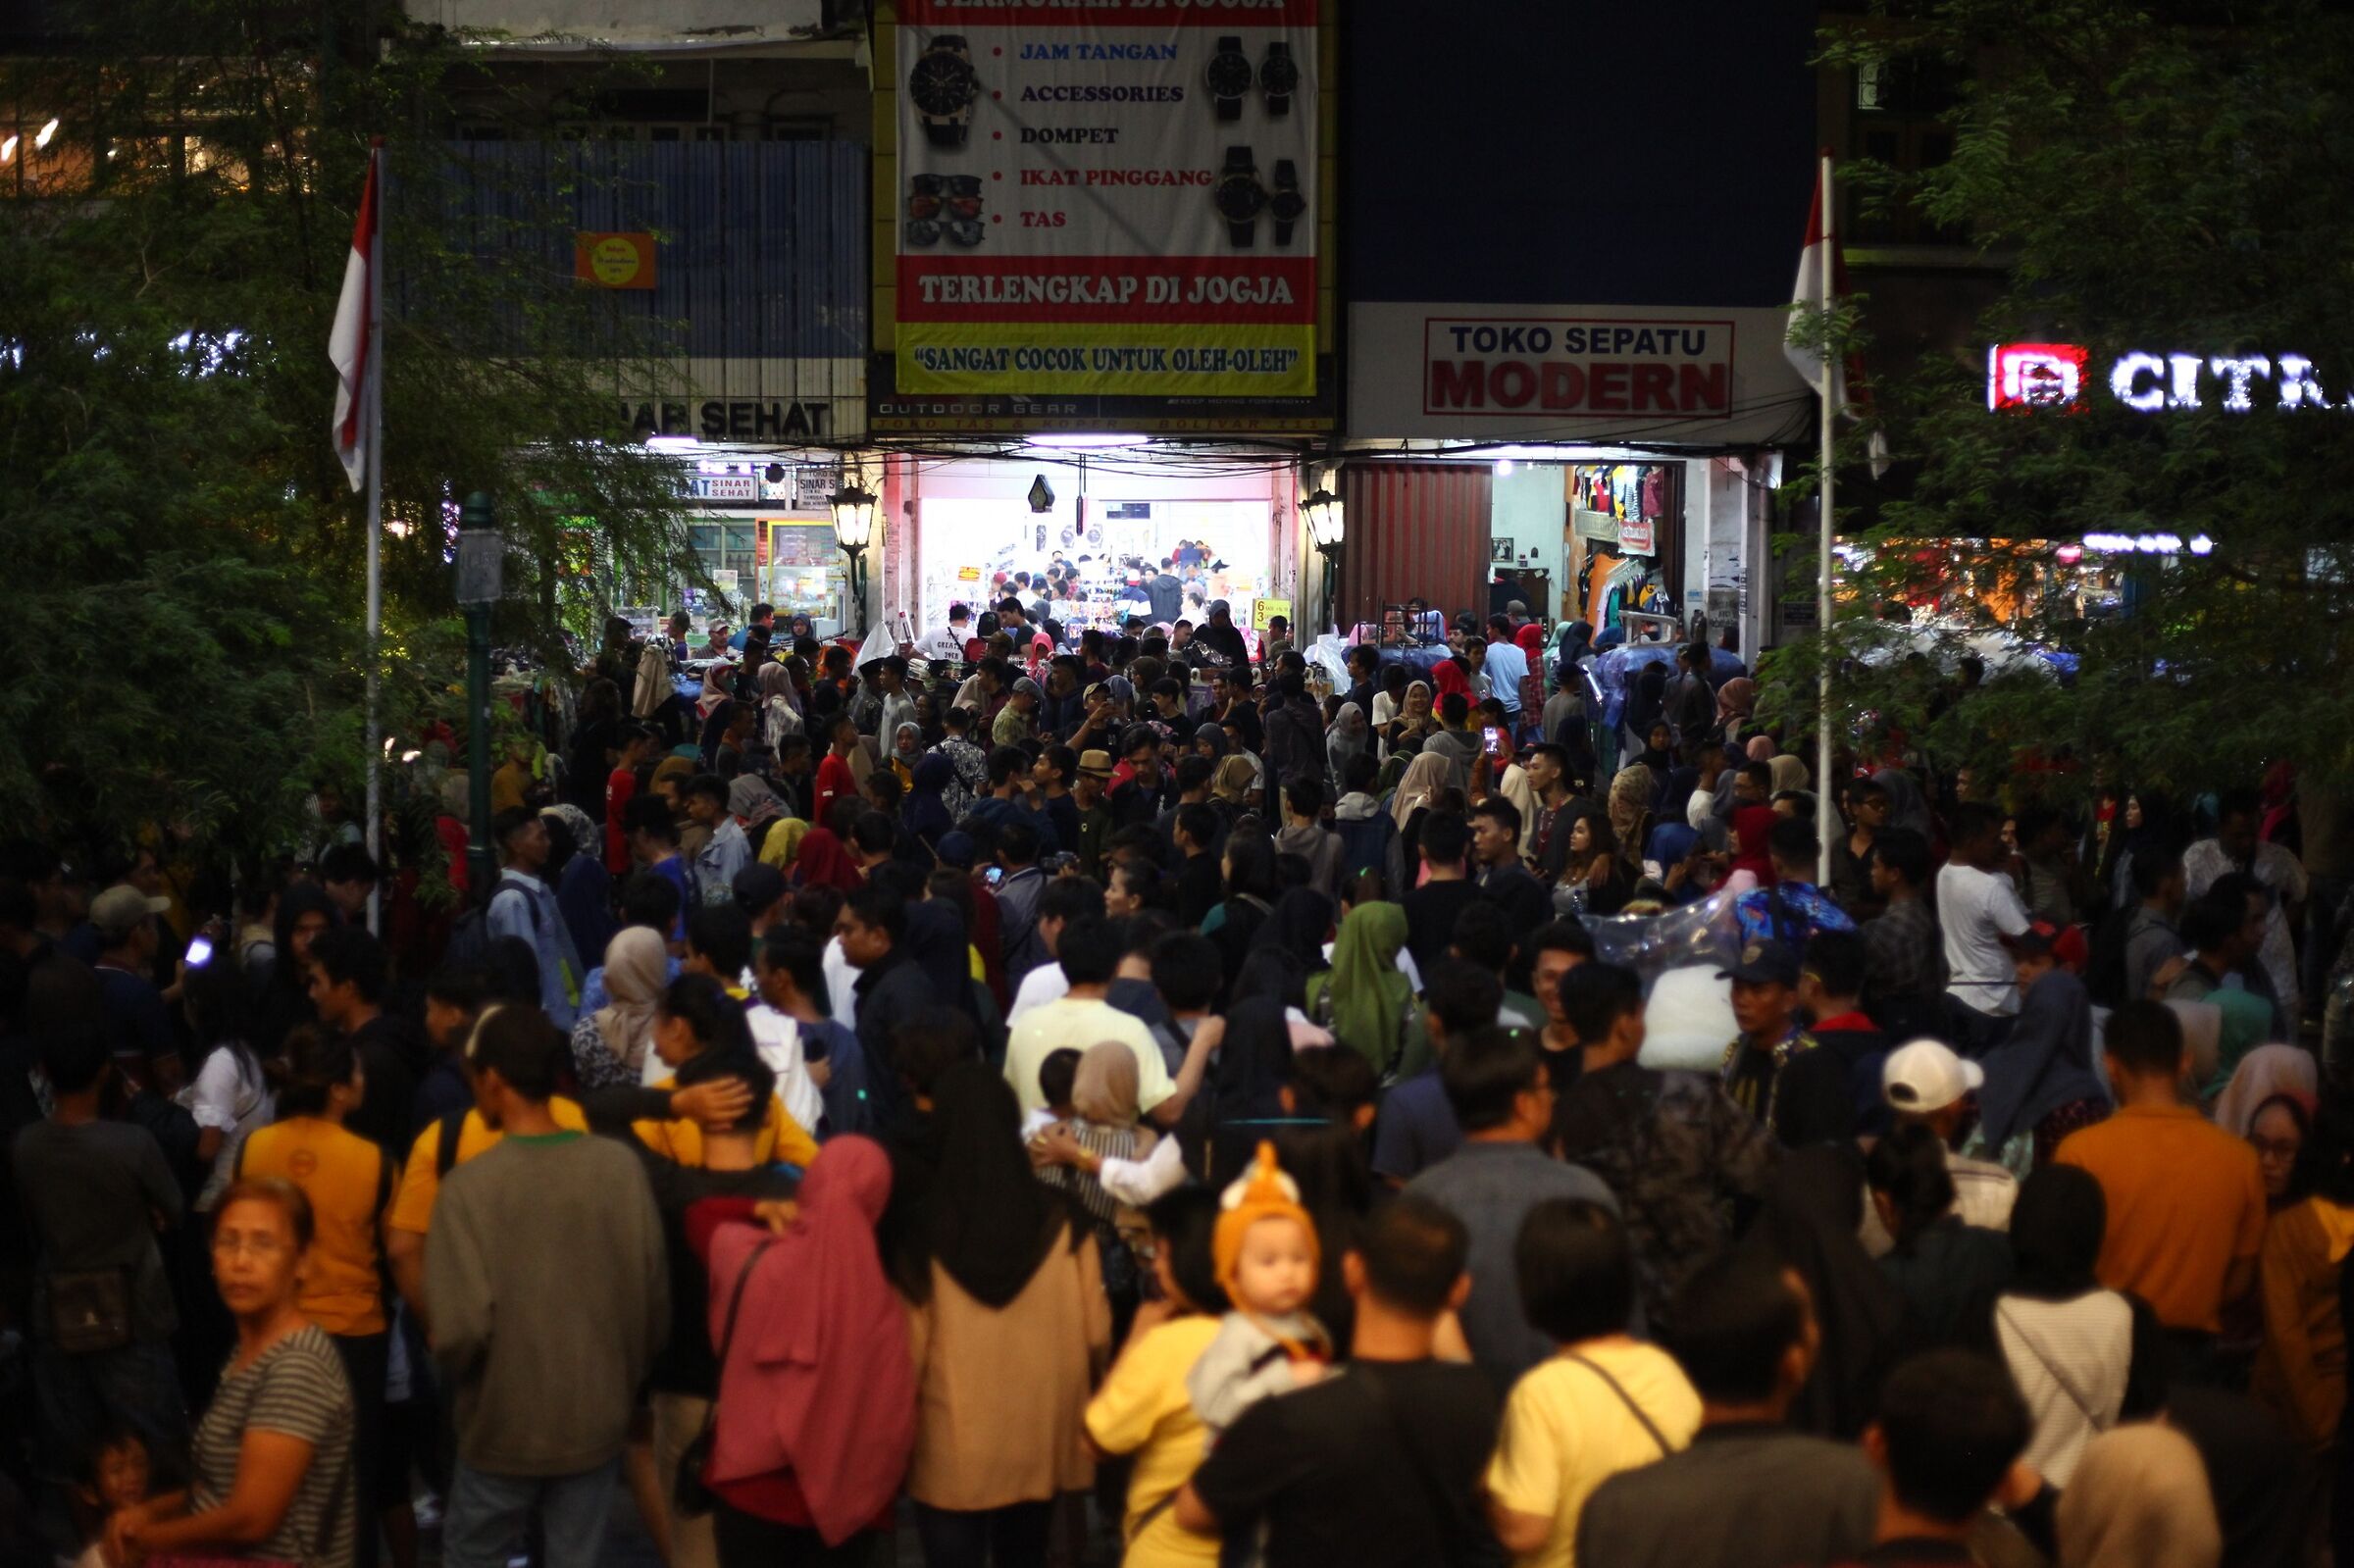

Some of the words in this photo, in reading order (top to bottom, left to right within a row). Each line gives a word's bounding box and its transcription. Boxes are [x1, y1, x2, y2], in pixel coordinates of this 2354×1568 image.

[1020, 44, 1070, 60] JAM
[1076, 44, 1177, 60] TANGAN
[1020, 86, 1183, 102] ACCESSORIES
[1020, 128, 1118, 144] DOMPET
[1020, 171, 1079, 186] IKAT
[1086, 171, 1213, 186] PINGGANG
[1020, 212, 1066, 228] TAS
[919, 276, 1138, 304] TERLENGKAP
[1146, 277, 1181, 304] DI
[1187, 278, 1294, 304] JOGJA
[1450, 327, 1552, 354] TOKO
[1564, 328, 1706, 356] SEPATU
[1014, 347, 1087, 372] COCOK
[1092, 348, 1167, 372] UNTUK
[1431, 361, 1726, 411] MODERN
[879, 403, 999, 415] OUTDOOR
[1013, 403, 1077, 415] GEAR
[700, 402, 829, 435] SEHAT
[877, 419, 937, 430] TOKO
[955, 419, 995, 430] TAS
[1042, 420, 1118, 430] KOPER
[1157, 420, 1260, 430] BOLIVAR
[1276, 420, 1320, 430] III
[800, 479, 826, 489] SINAR
[1257, 600, 1264, 612] 6
[1256, 611, 1264, 622] 3
